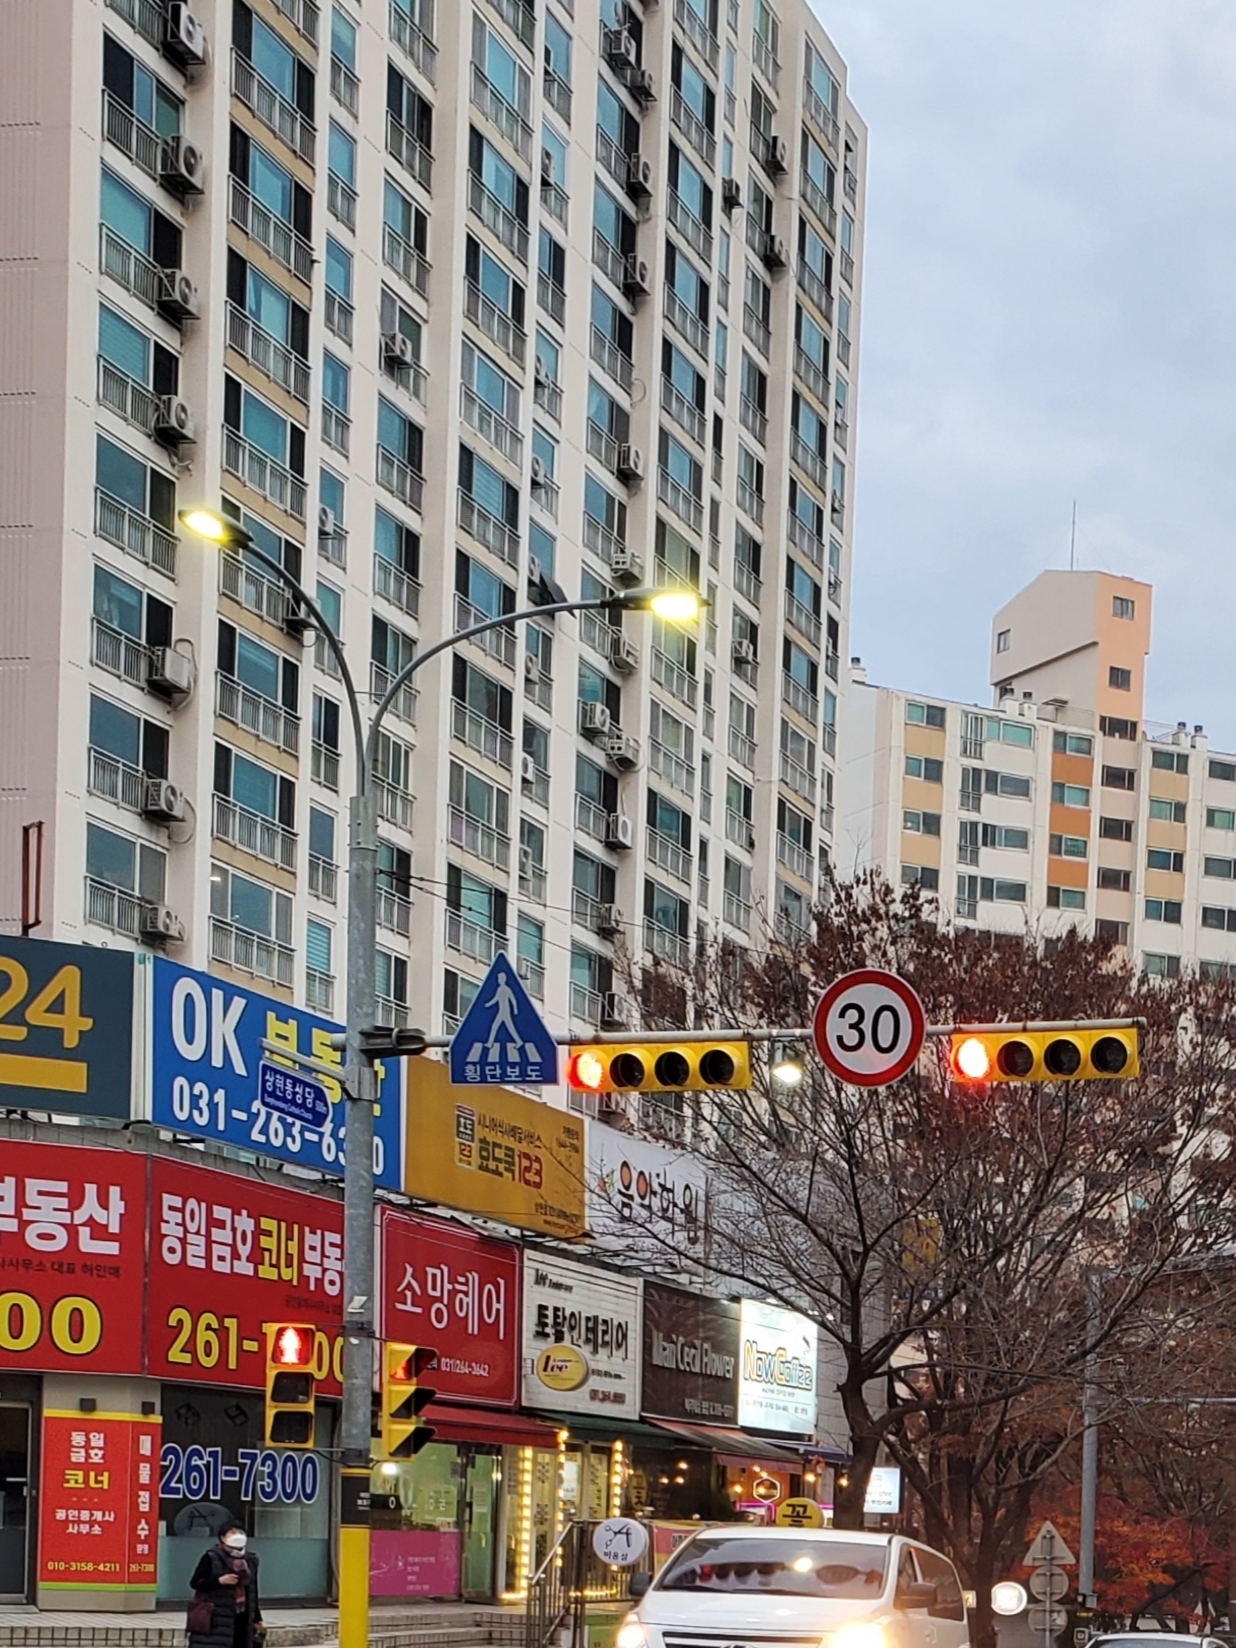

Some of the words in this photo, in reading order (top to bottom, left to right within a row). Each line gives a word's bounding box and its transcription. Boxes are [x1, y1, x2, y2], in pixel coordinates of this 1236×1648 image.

[0, 955, 94, 1049] 24
[172, 976, 248, 1077] OK
[836, 1002, 900, 1055] 30
[463, 1063, 544, 1082] 횡단보도
[264, 1069, 315, 1109] 상현동성당
[394, 1262, 505, 1341] 소망헤어
[0, 1290, 103, 1355] 00
[534, 1303, 629, 1361] 토탈인테리어
[70, 1430, 105, 1448] 동일
[69, 1447, 105, 1464] 금호
[62, 1469, 110, 1490] 코너
[159, 1442, 320, 1505] 261-7300
[54, 1508, 116, 1522] 공인중개사
[65, 1523, 103, 1536] 사무소
[46, 1560, 121, 1573] 010-3158-4211
[603, 1550, 629, 1561] 미용실
